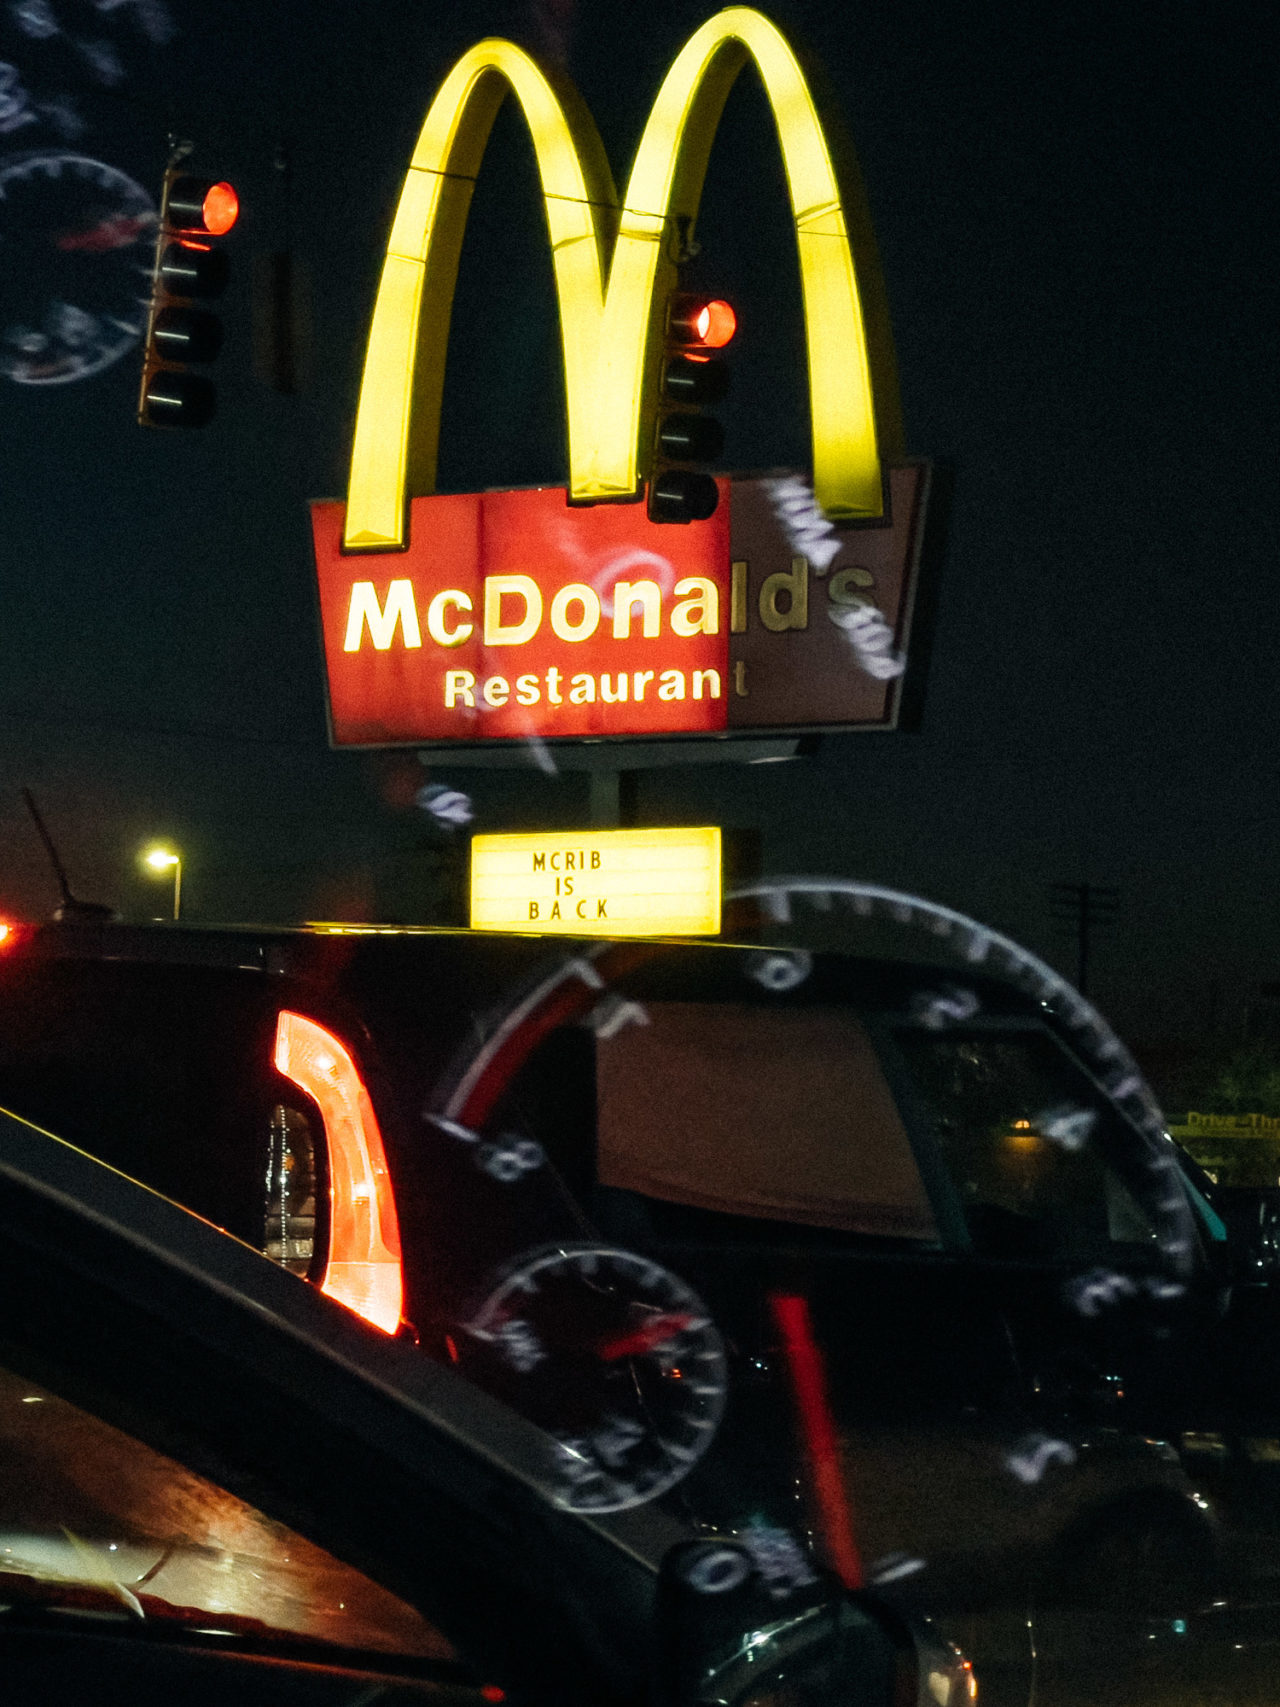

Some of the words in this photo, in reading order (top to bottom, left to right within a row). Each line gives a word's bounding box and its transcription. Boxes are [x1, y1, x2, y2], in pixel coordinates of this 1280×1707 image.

[444, 661, 749, 709] Restaurant
[532, 850, 601, 872] MCRIB
[555, 876, 574, 896] IS
[528, 899, 608, 920] BACK
